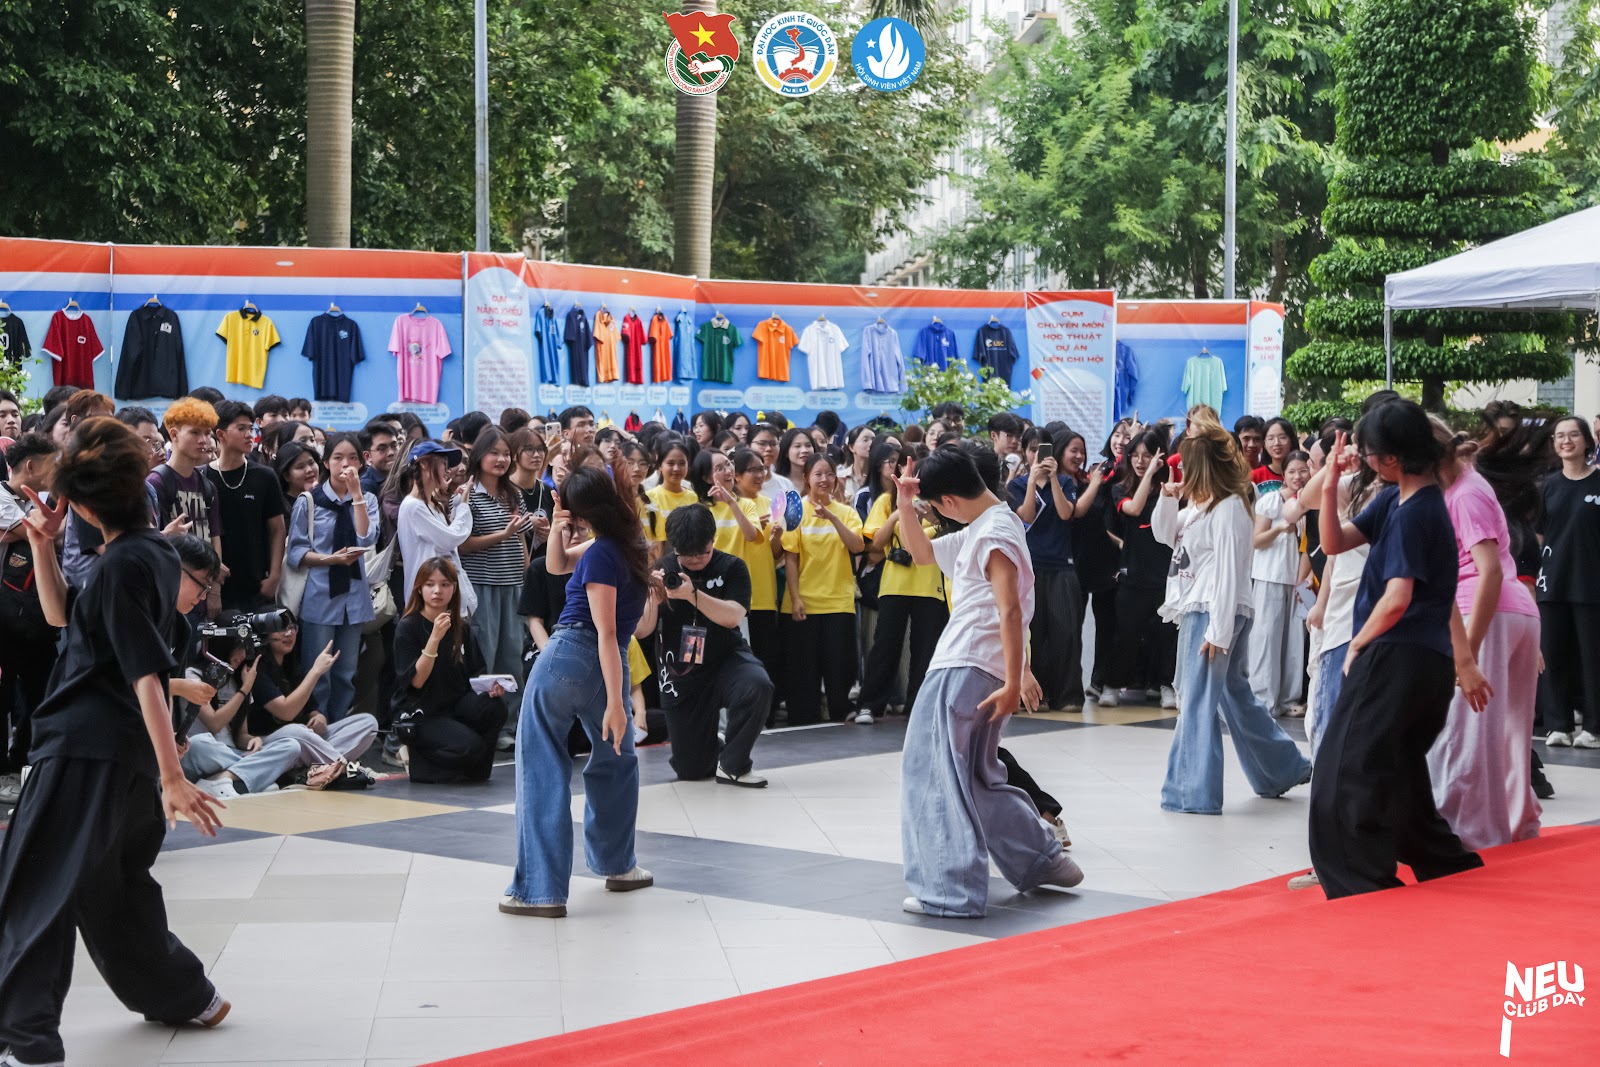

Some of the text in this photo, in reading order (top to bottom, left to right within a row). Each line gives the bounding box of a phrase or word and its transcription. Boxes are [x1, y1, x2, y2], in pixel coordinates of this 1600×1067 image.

[1061, 311, 1084, 319] CỤM
[1037, 320, 1105, 329] CHUYÊN MÔN
[1043, 332, 1102, 342] HỌC THUẬT
[1056, 344, 1070, 352] DỰ
[1087, 354, 1104, 364] HỘI
